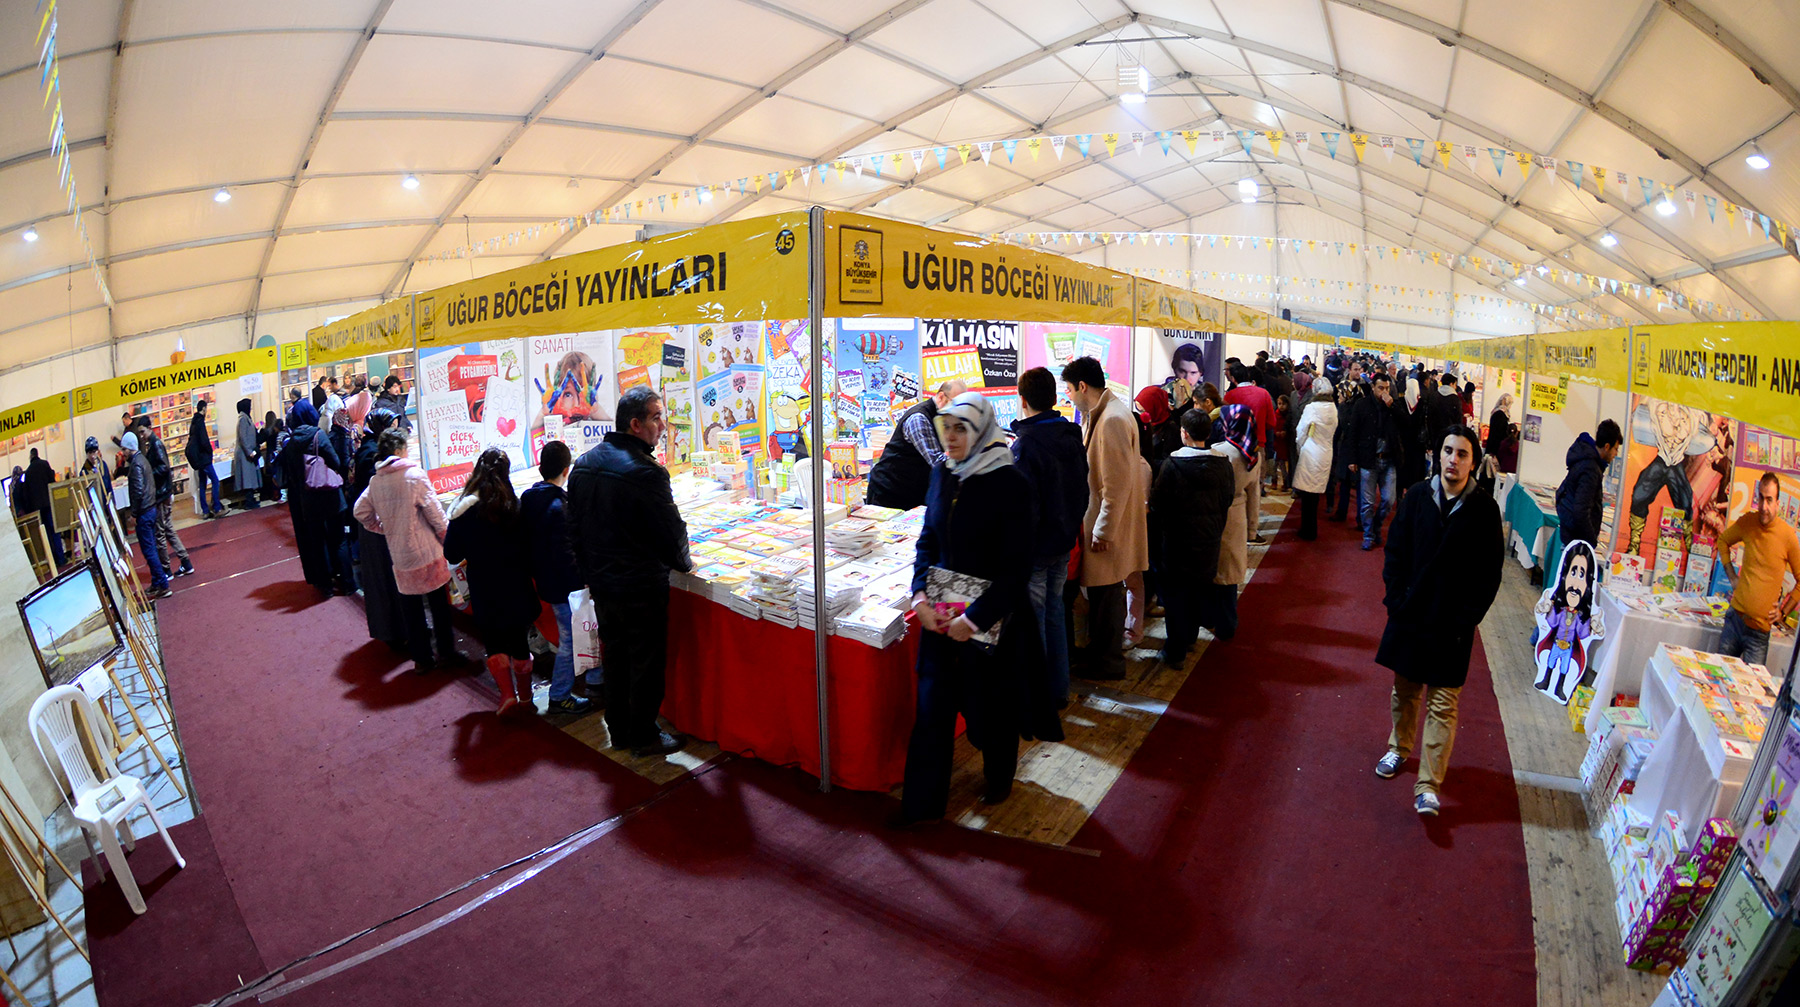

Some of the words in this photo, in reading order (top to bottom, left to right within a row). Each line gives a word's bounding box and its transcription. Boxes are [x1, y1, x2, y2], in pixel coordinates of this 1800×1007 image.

[777, 234, 793, 250] 45
[853, 261, 871, 269] KONYA
[903, 243, 974, 293] UĞUR
[982, 256, 1049, 300] BÖCEĞİ
[1053, 275, 1113, 308] YAYINLARI
[448, 293, 489, 327] UĞUR
[493, 270, 568, 319] BÖCEĞİ
[576, 252, 726, 307] YAYINLARI
[352, 323, 365, 344] CAN
[366, 313, 400, 342] YAYINLARI
[922, 323, 1018, 351] KALMASIN
[534, 338, 574, 355] SANATI
[120, 375, 166, 397] KÖMEN
[170, 361, 236, 385] YAYINLARI
[772, 366, 801, 379] ZEKA
[984, 368, 1003, 378] Özkan
[1003, 368, 1017, 378] Öze
[1549, 402, 1556, 411] 5
[450, 430, 479, 445] ÇİÇEK
[446, 442, 481, 457] BAHÇESİ
[719, 445, 734, 454] ZEKA
[692, 466, 709, 474] ZEKA
